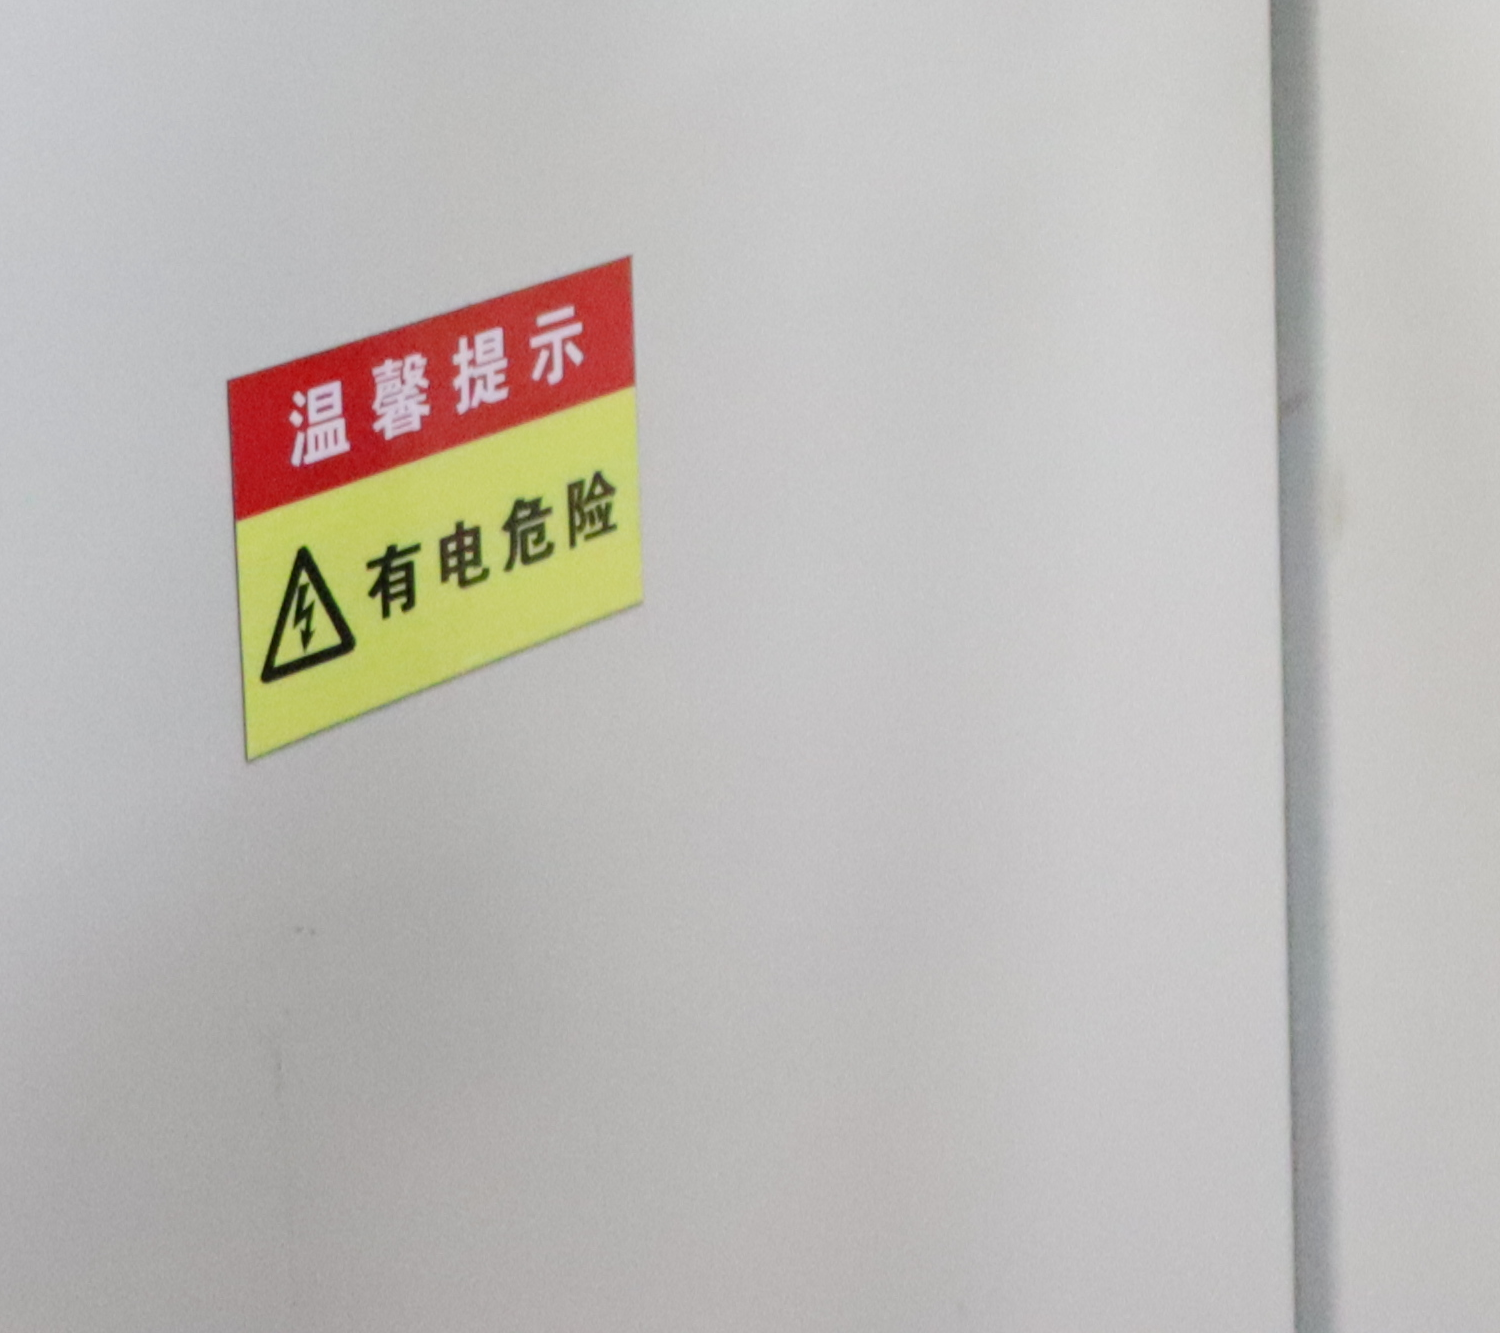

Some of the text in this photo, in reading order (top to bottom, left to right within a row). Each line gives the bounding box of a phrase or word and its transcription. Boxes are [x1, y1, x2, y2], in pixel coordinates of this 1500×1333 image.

[288, 305, 584, 467] 温馨提示
[366, 470, 618, 620] 有电危险
